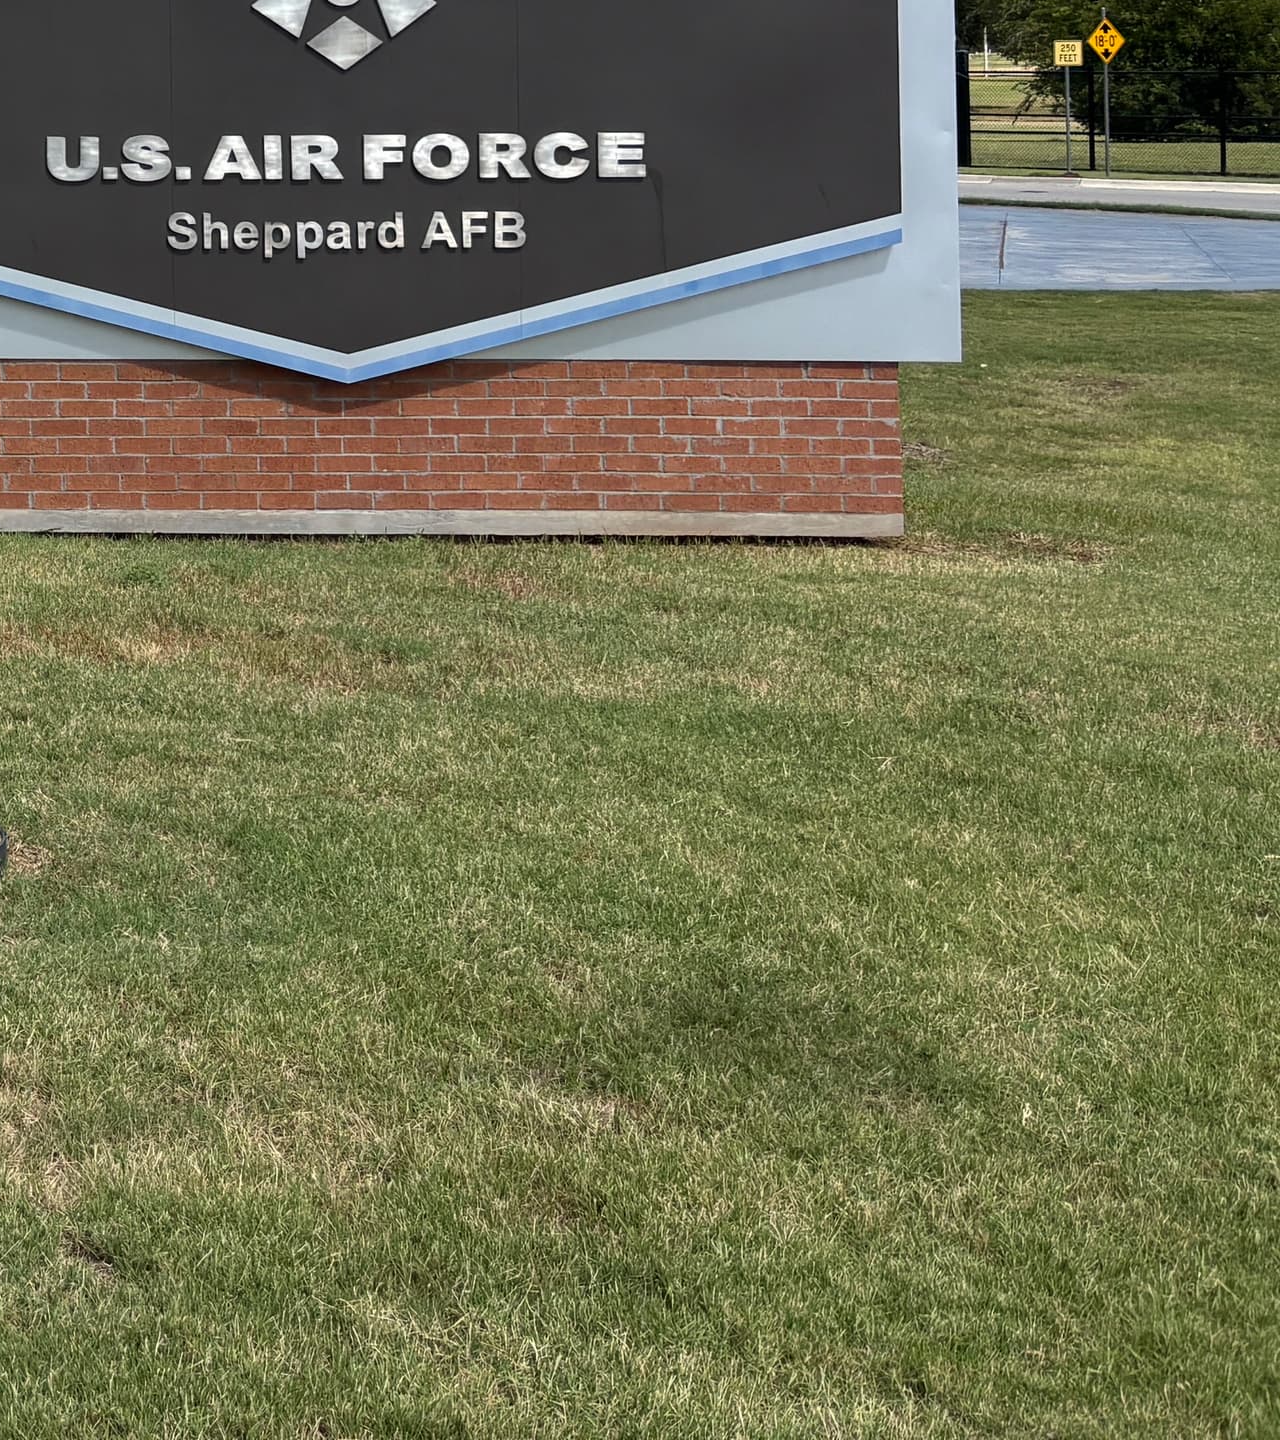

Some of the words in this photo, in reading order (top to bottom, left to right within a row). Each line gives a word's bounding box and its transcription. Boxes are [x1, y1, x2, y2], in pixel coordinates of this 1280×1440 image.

[1059, 54, 1077, 62] FEET
[1060, 44, 1076, 52] 250
[46, 134, 191, 182] U.S.
[203, 134, 344, 180] AIR
[362, 132, 647, 180] FORCE
[167, 211, 405, 259] Sheppard
[421, 210, 527, 249] AFB
